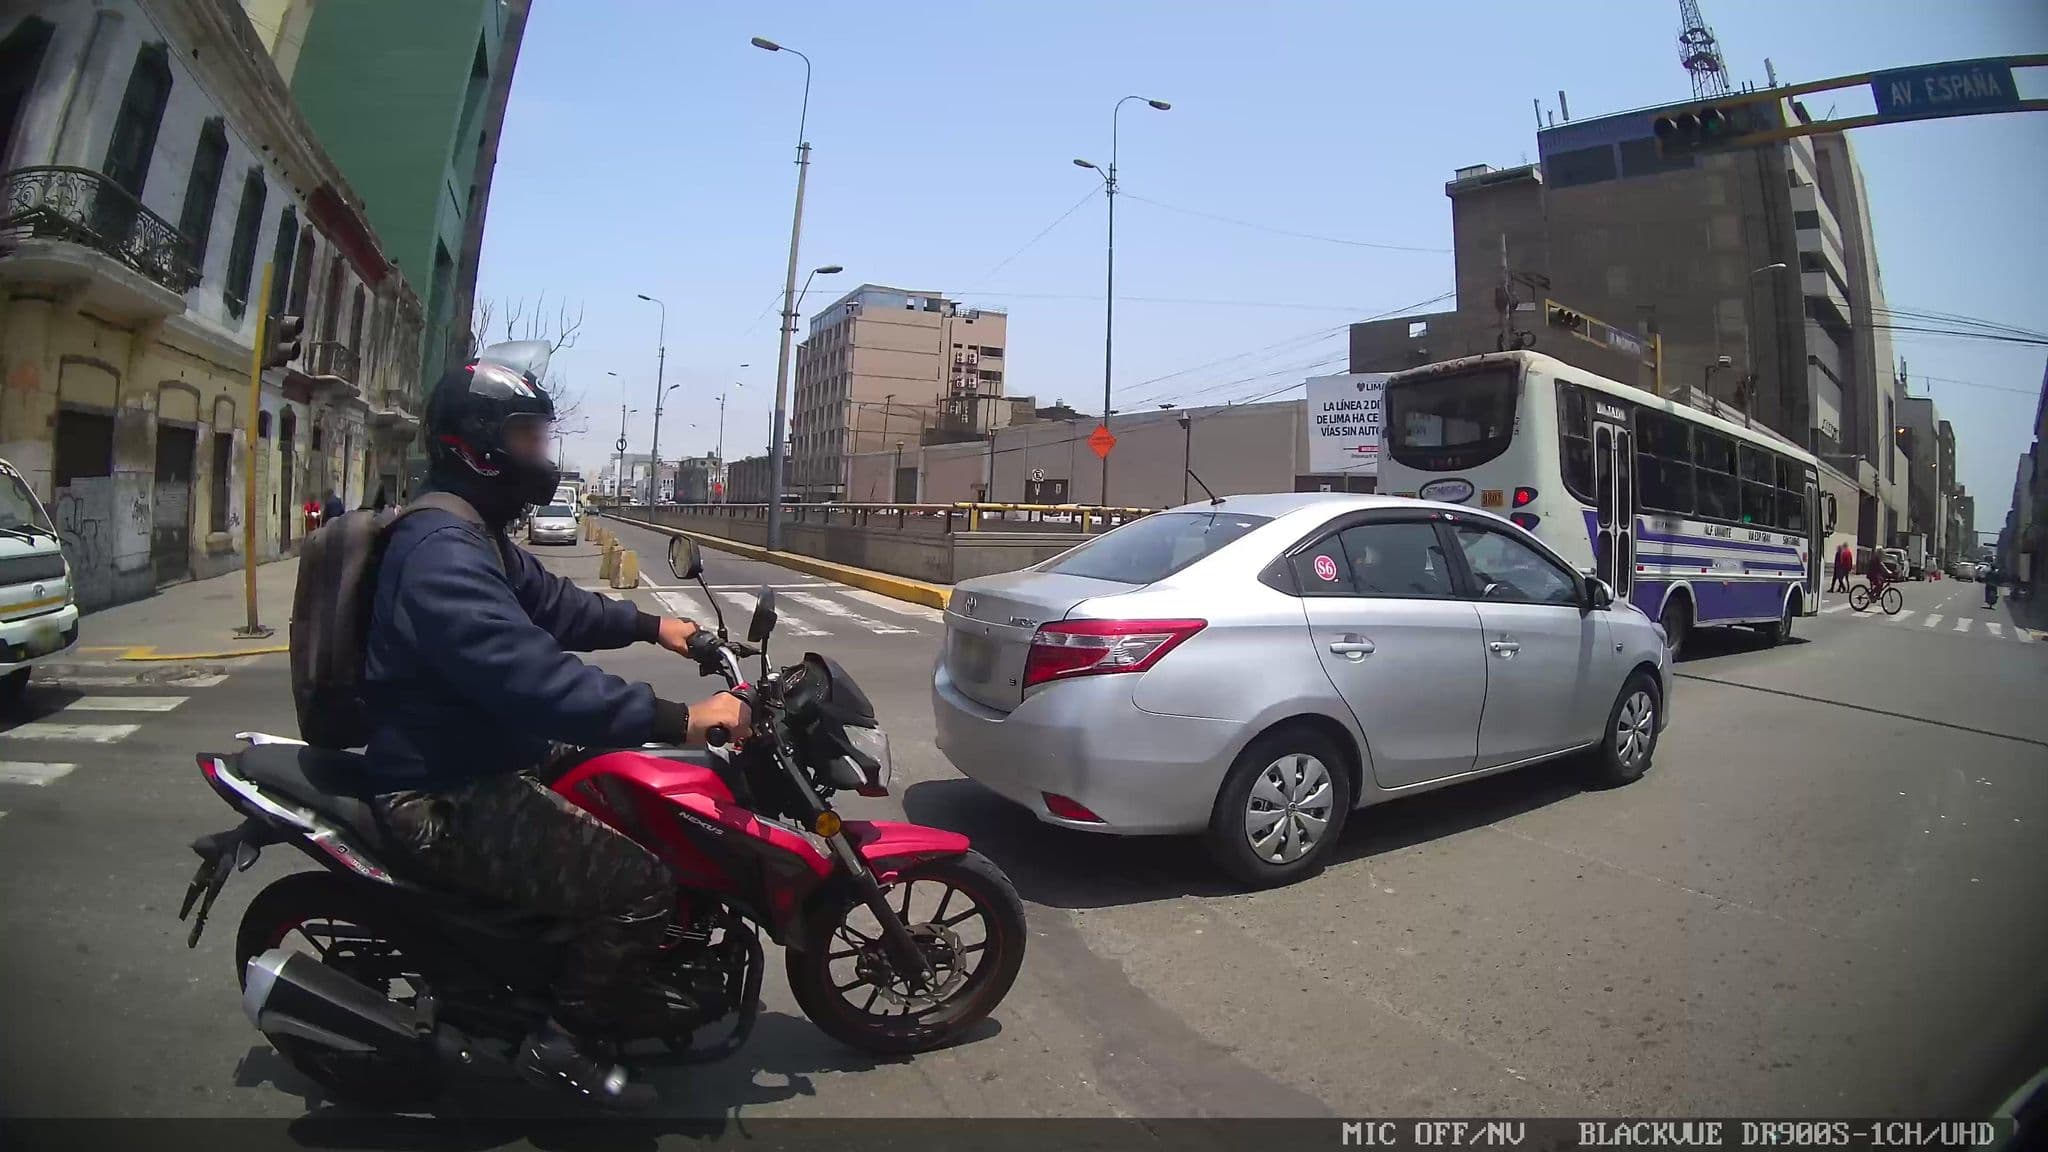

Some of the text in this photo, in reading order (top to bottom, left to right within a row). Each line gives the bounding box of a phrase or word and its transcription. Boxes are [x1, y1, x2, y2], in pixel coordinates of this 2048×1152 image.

[1924, 68, 2002, 103] ESPAÑA
[1323, 402, 1336, 411] LA
[1336, 399, 1362, 411] LÍNEA
[1363, 400, 1370, 410] 2
[1316, 415, 1328, 424] DE
[1329, 413, 1351, 424] LIMA
[1352, 413, 1365, 423] HA
[1321, 425, 1341, 436] VÍAS
[1342, 426, 1357, 436] SIN
[1317, 560, 1334, 575] S6
[678, 811, 725, 835] NEXUS
